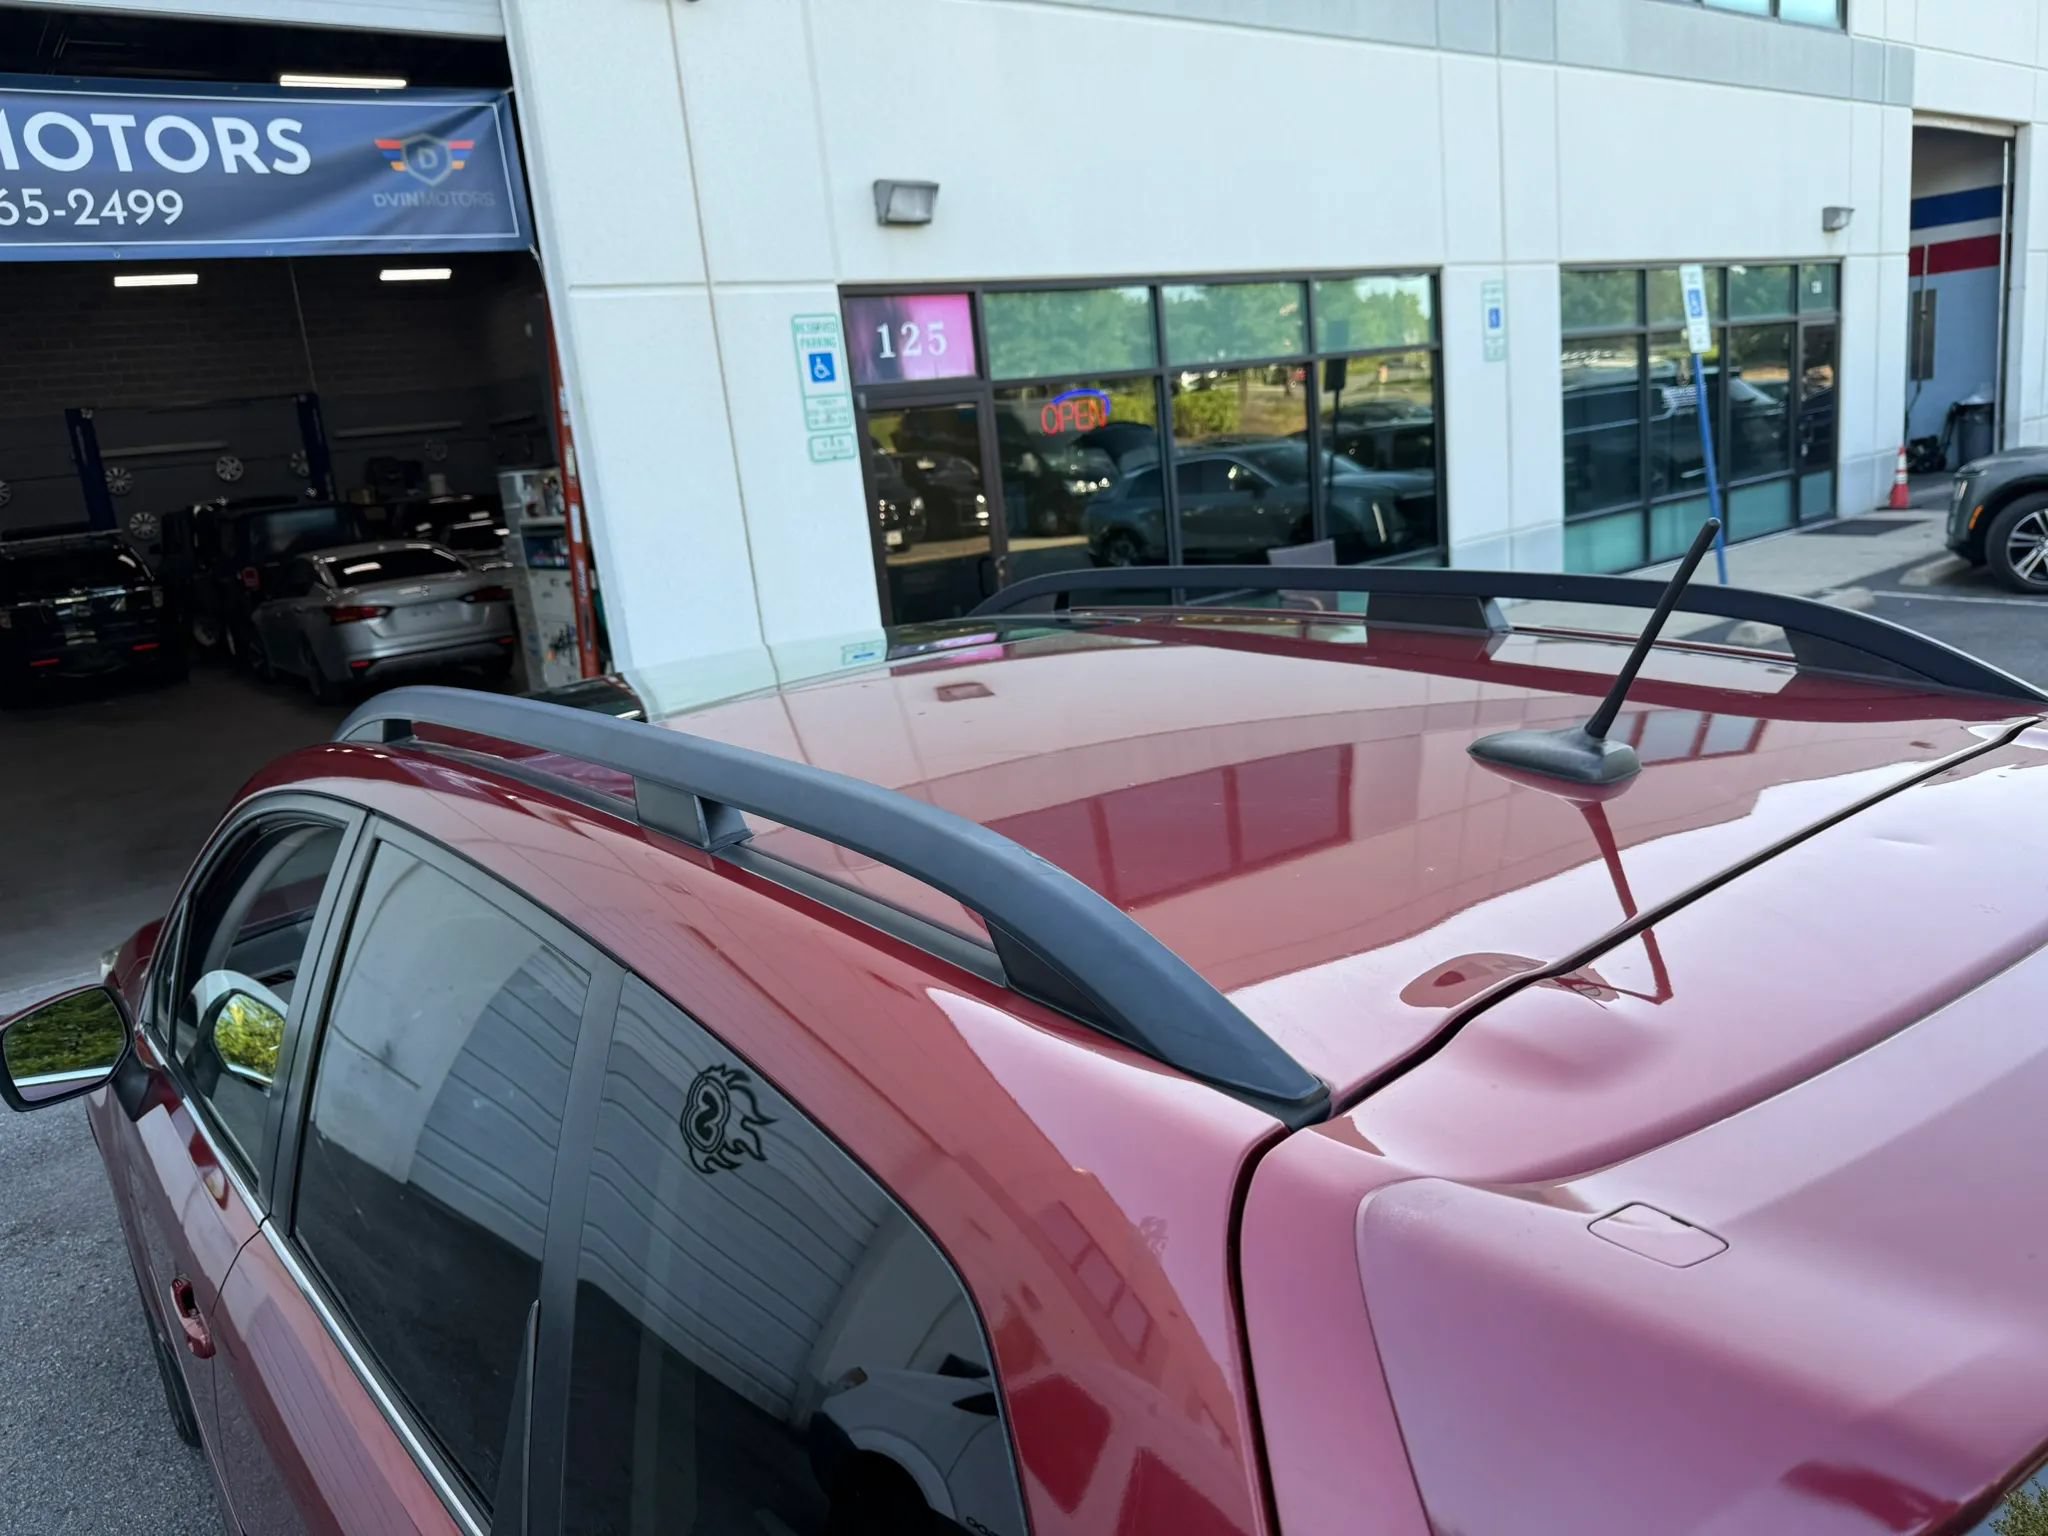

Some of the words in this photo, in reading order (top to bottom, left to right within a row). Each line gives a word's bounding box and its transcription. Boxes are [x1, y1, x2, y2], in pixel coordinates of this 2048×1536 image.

[0, 188, 183, 226] 65-2499
[876, 321, 948, 358] 125
[1041, 397, 1107, 436] OPEN
